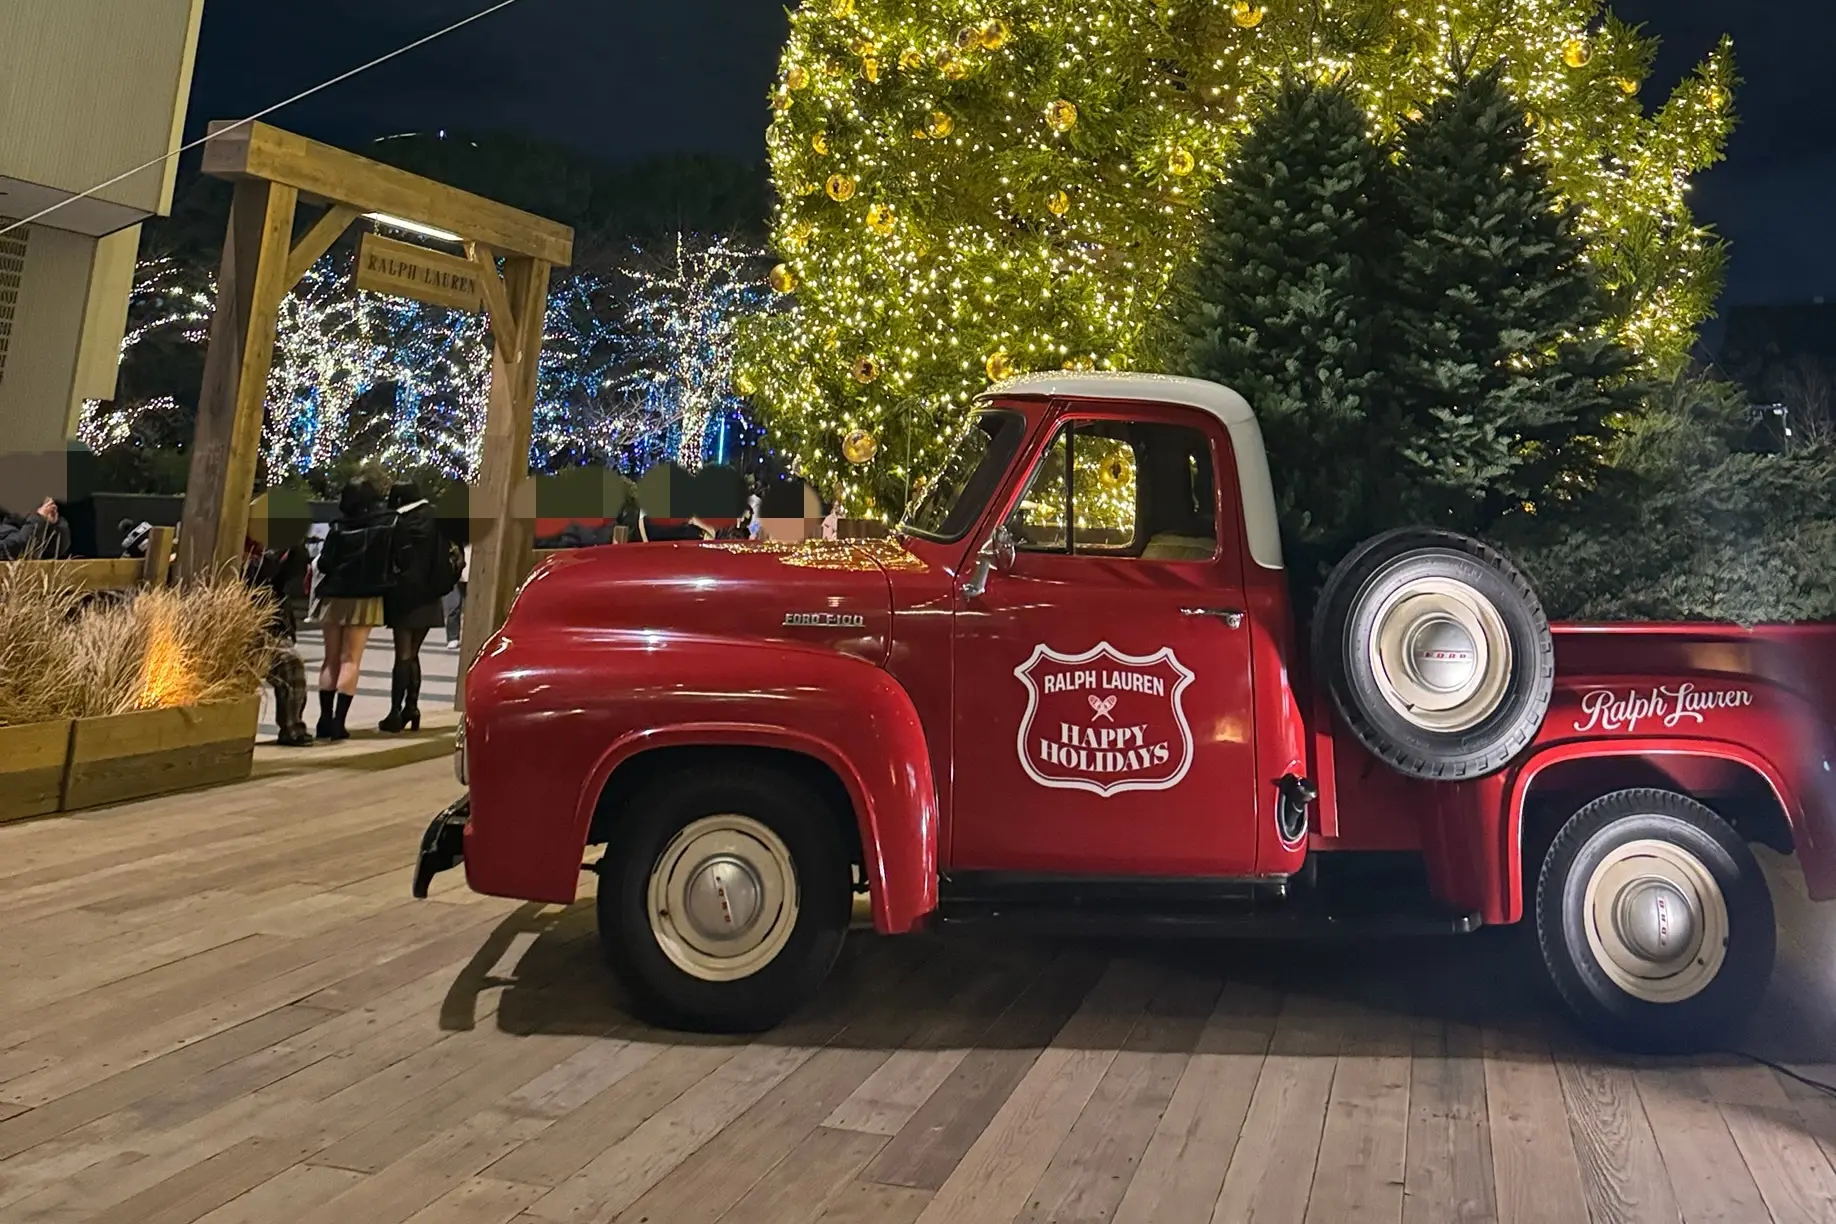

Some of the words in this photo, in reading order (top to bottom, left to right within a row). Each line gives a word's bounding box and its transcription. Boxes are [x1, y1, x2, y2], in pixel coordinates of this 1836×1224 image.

[368, 254, 417, 280] RALPH
[424, 267, 476, 294] LAUREN
[785, 613, 820, 625] FORD
[1044, 670, 1097, 694] RALPH
[1102, 670, 1164, 696] LAUREN
[1573, 688, 1667, 732] Ralph
[1659, 682, 1753, 728] Lauren
[1060, 722, 1148, 749] HAPPY
[1039, 738, 1169, 772] HOLIDAYS
